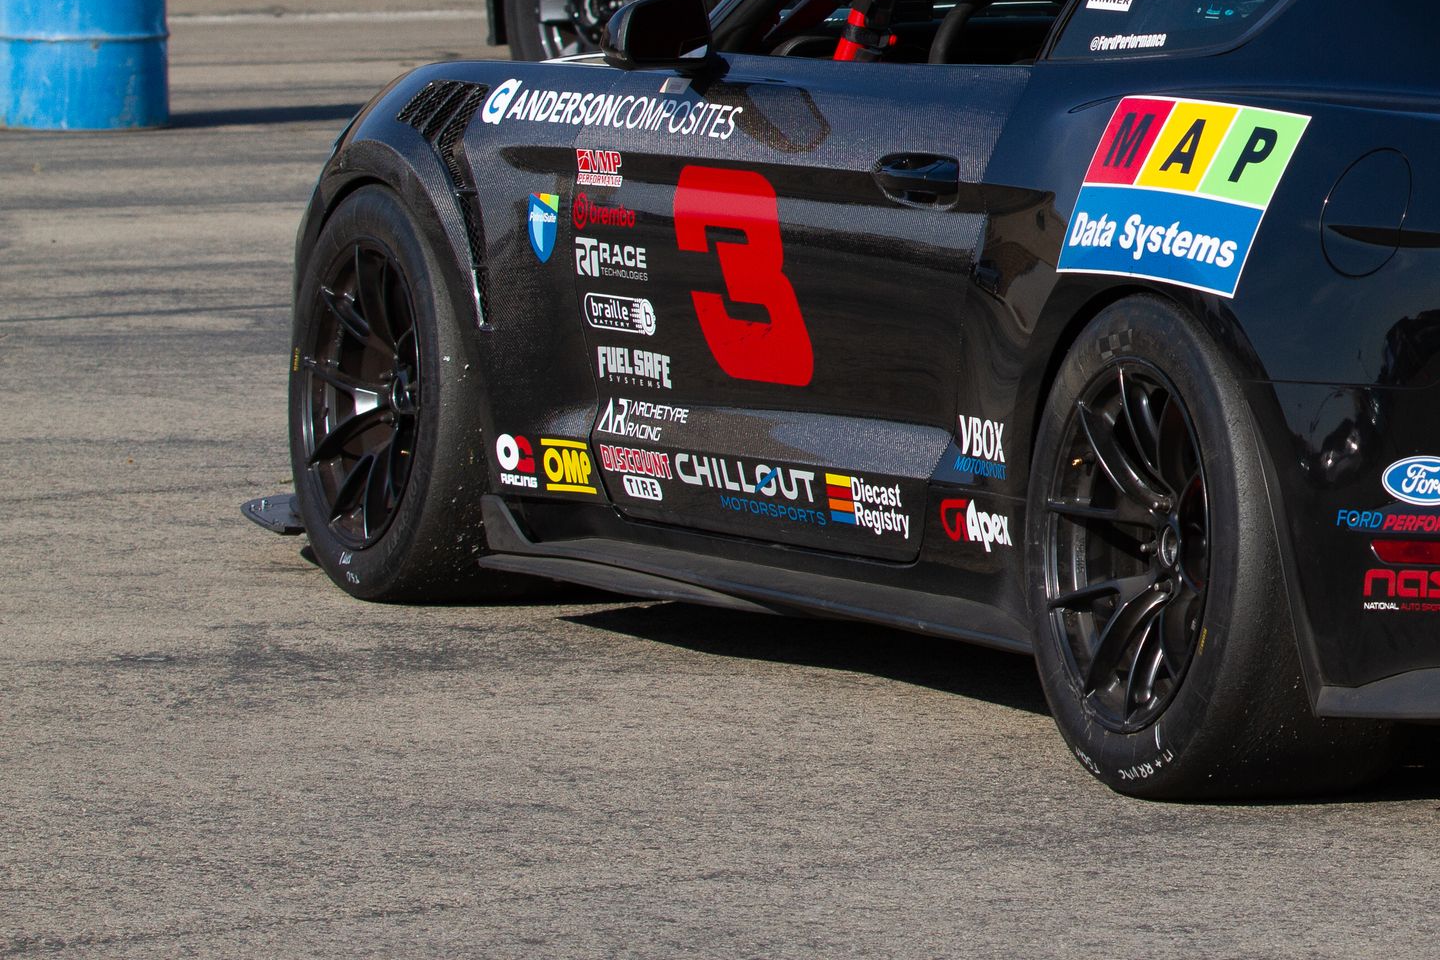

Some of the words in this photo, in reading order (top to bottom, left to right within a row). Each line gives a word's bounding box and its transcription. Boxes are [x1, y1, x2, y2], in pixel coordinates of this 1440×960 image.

[1090, 33, 1167, 51] @FordPerformance
[589, 149, 622, 174] VMP
[589, 198, 636, 228] brembo
[1068, 212, 1117, 248] Data
[1119, 213, 1238, 268] Systems
[599, 242, 647, 269] RACE
[600, 267, 649, 282] TECHNOLOGIES
[673, 165, 814, 387] 3
[590, 297, 630, 321] braille
[608, 374, 661, 389] SYSTEMS
[630, 400, 690, 424] ARCHETYPE
[626, 423, 663, 441] RACING
[958, 414, 1006, 463] VBOX
[543, 447, 592, 485] OMP
[600, 443, 674, 480] DISCOUNT
[952, 455, 1007, 481] MOTORSPORT
[500, 472, 539, 489] RACING
[627, 478, 660, 499] TIRE
[675, 452, 815, 503] CHILLOUT
[850, 476, 903, 509] Diecast
[720, 494, 828, 526] MOTORSPORTS
[854, 501, 910, 540] Registry
[1336, 509, 1383, 529] FORD
[1363, 602, 1400, 611] NATIONAL
